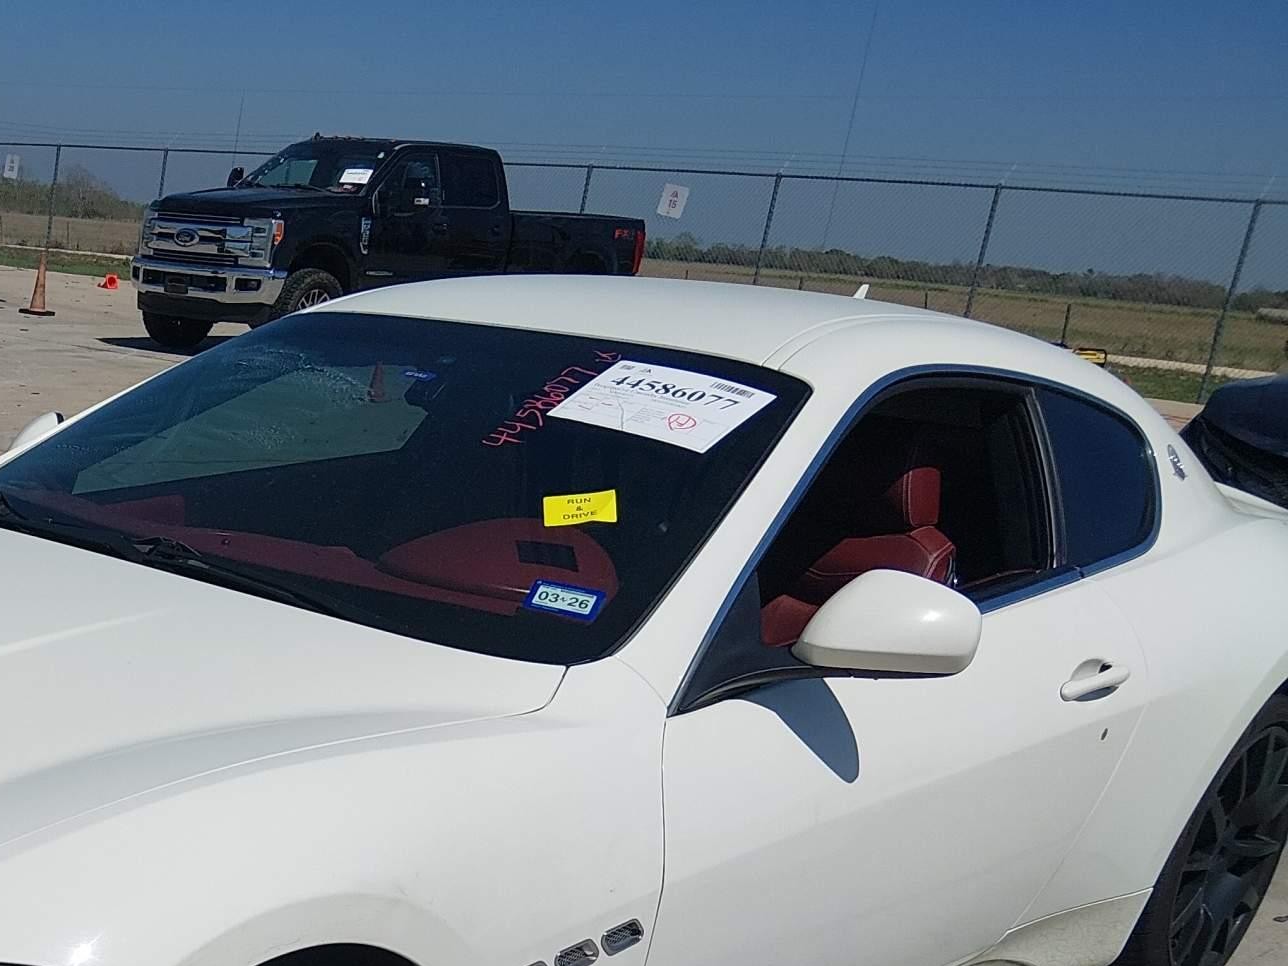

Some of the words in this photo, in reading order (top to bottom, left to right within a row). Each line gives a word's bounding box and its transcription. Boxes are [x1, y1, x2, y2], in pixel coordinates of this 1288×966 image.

[610, 375, 740, 410] 44586077
[567, 497, 591, 505] RUN
[562, 509, 598, 520] DRIVE
